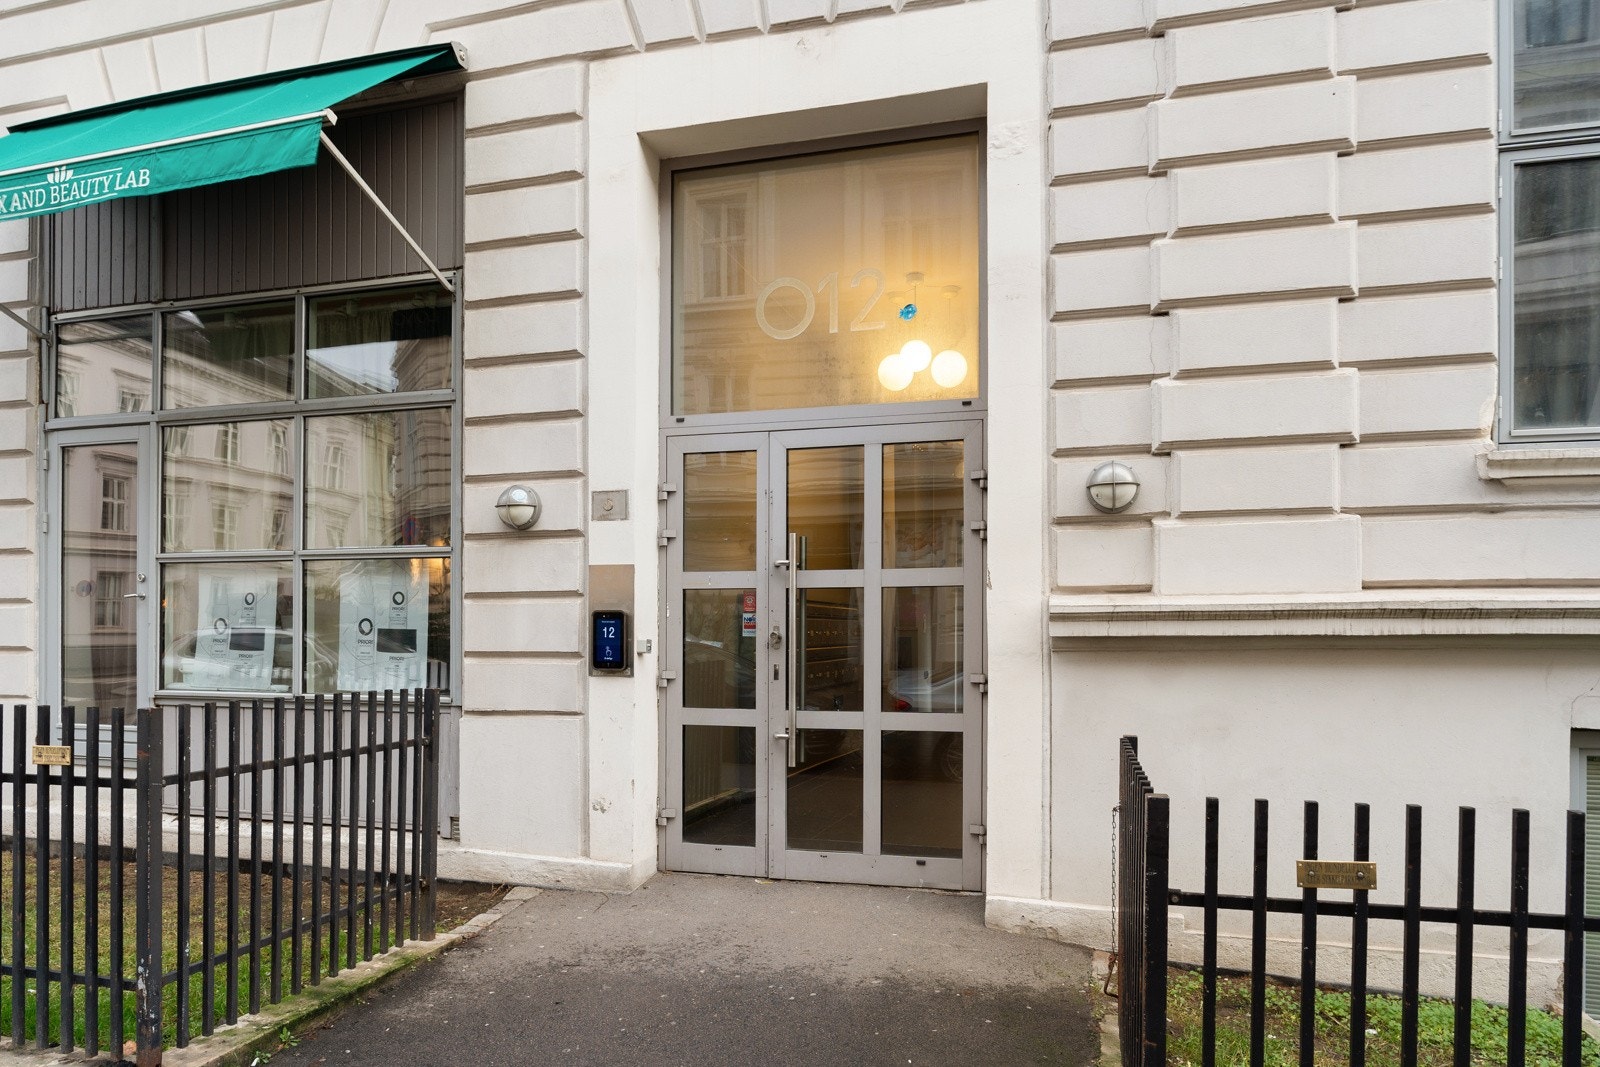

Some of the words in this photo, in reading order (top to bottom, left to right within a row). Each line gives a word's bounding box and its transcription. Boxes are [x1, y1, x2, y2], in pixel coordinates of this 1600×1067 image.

[9, 188, 46, 212] AND
[50, 175, 113, 205] BEAUTY
[114, 168, 151, 191] LAB
[602, 626, 615, 639] 12
